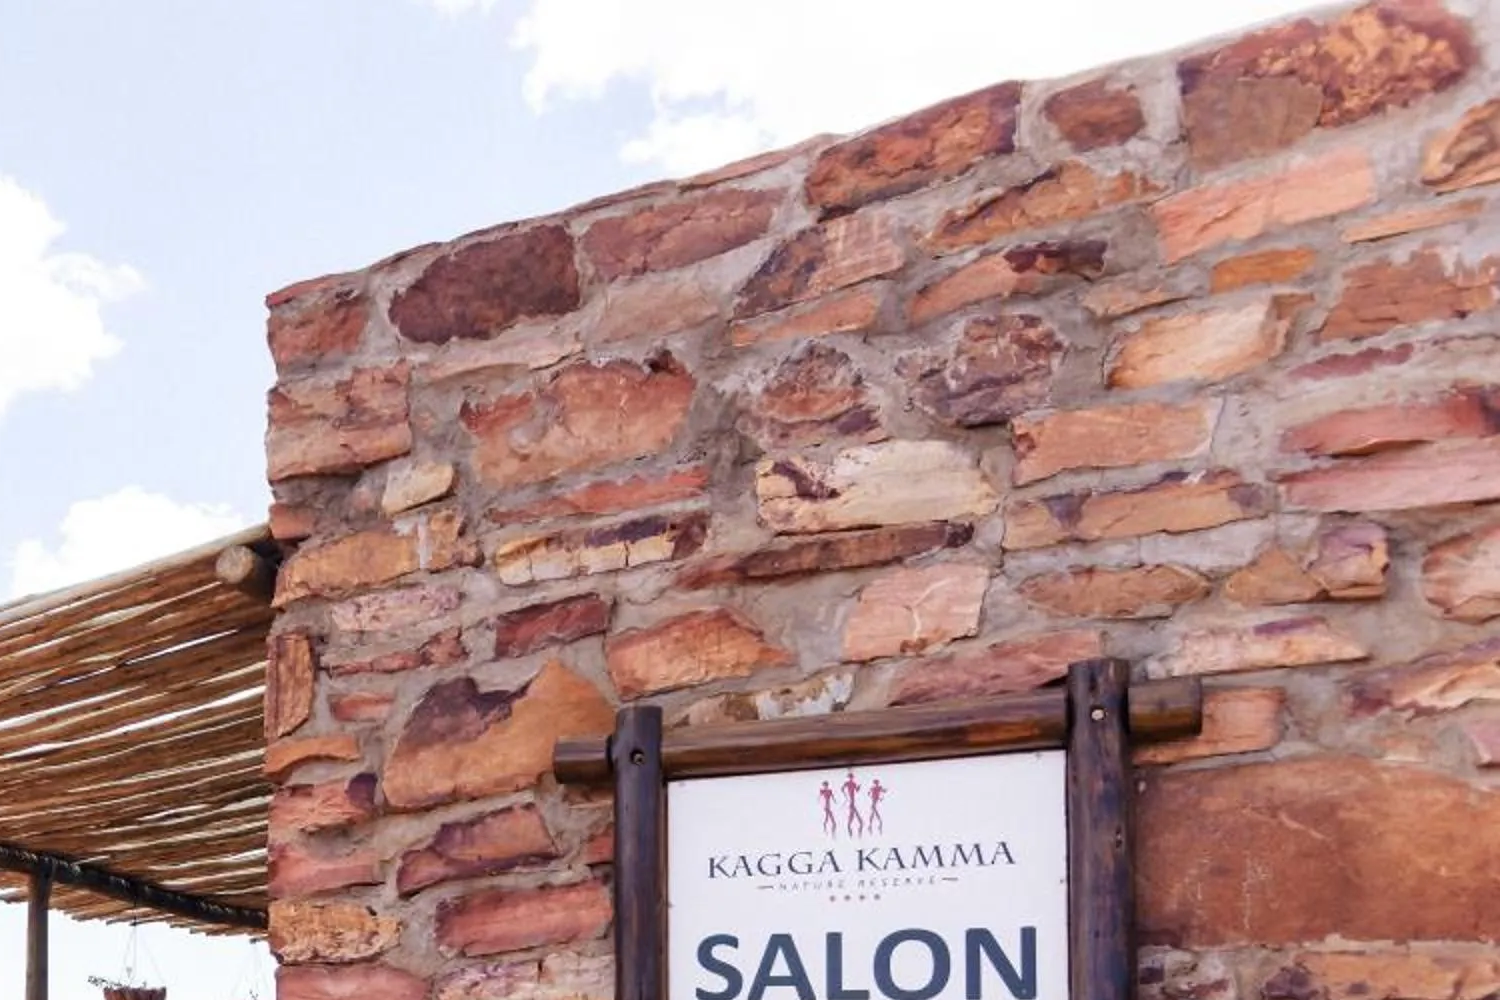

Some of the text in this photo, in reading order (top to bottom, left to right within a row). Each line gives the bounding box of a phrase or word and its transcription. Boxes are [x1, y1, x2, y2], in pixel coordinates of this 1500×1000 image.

[707, 841, 1016, 879] KAGGA KAMMA
[779, 875, 935, 891] NATURE RESERVE
